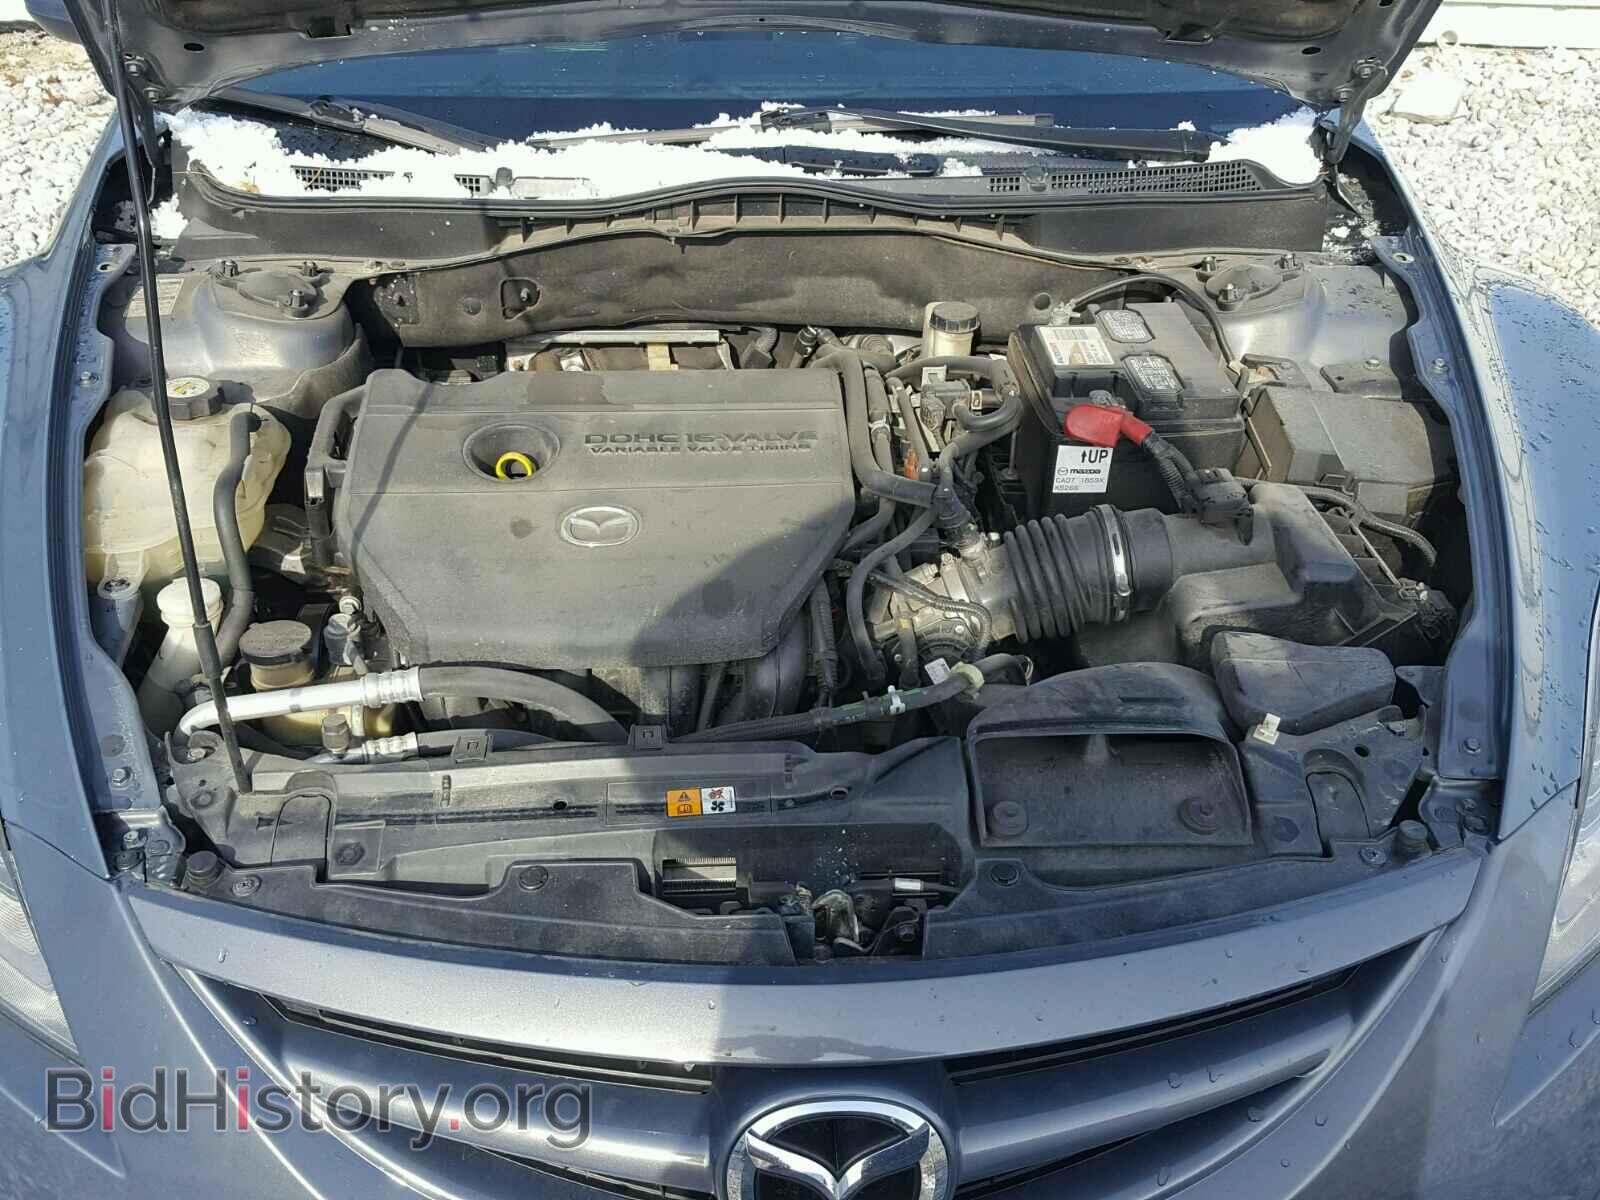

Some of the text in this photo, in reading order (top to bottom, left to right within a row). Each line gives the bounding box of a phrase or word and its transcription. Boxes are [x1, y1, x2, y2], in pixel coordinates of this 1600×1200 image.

[584, 432, 680, 444] DOHC
[590, 442, 812, 455] VARIABLE VALVE TIMING
[1087, 449, 1109, 464] UP
